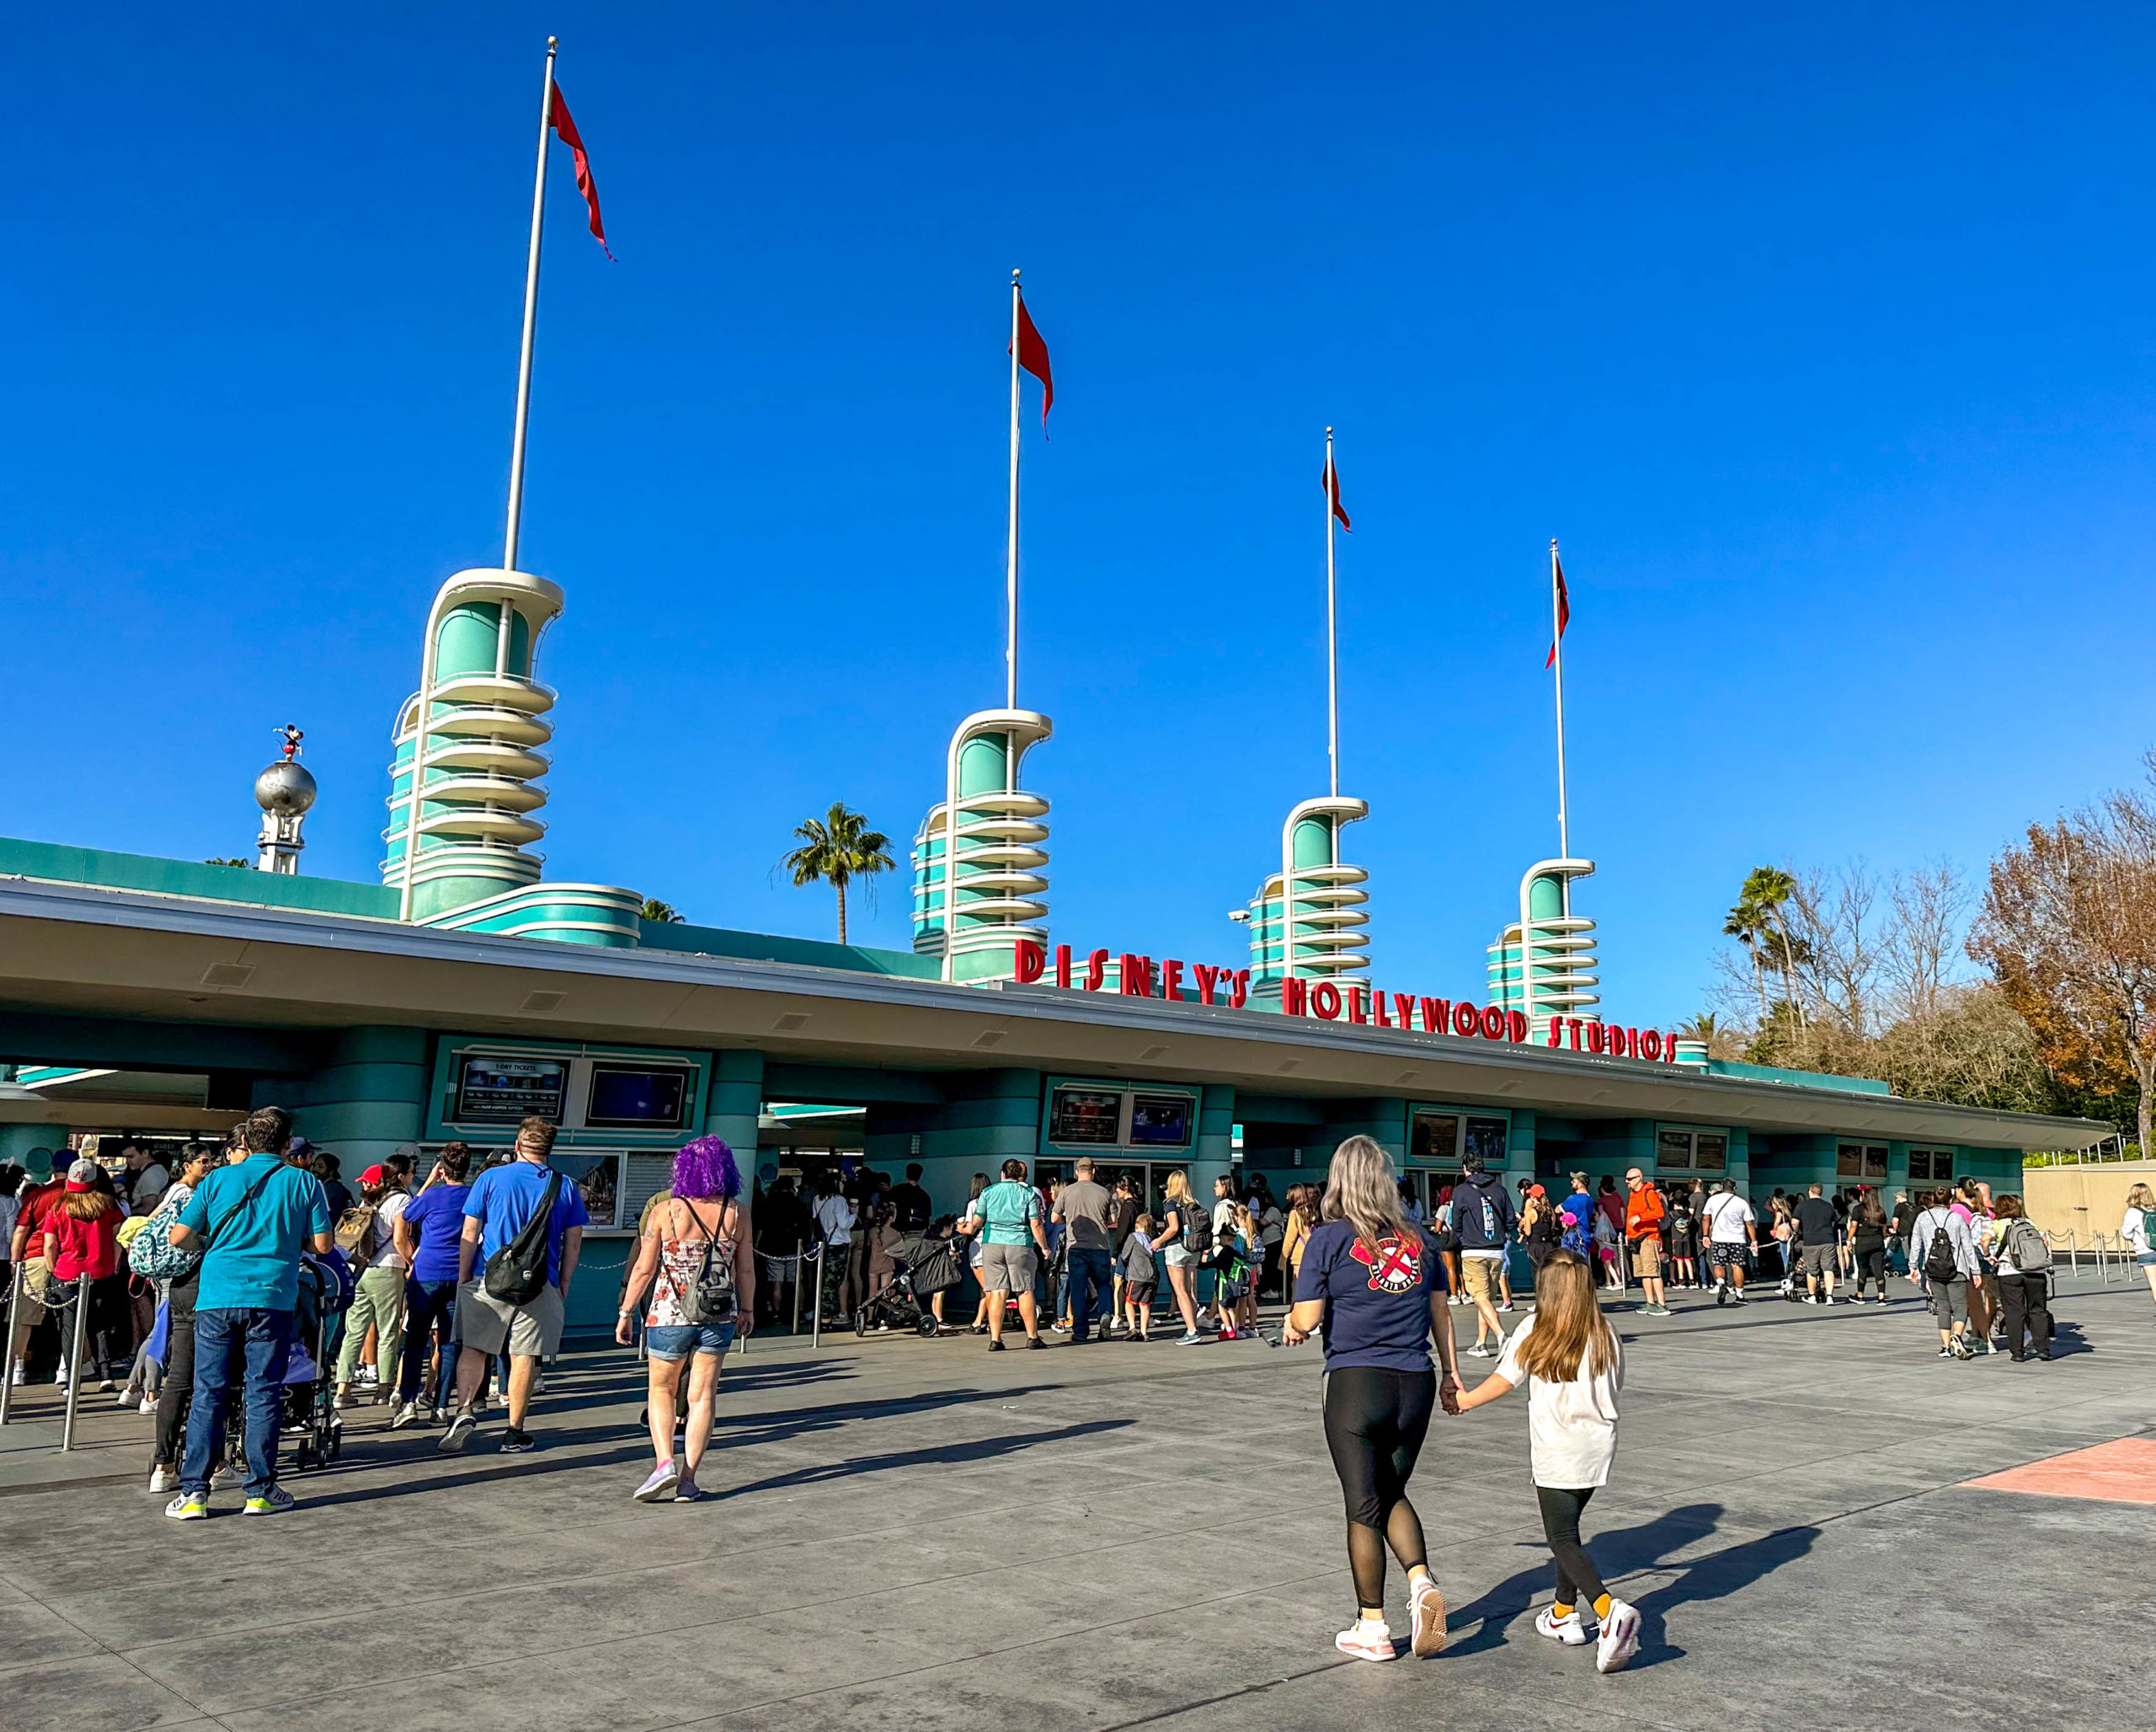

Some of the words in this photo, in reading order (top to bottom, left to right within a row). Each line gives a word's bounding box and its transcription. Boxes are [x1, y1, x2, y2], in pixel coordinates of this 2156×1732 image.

[1013, 938, 1251, 1009] DISNEY'S
[1282, 976, 1527, 1044] HOLLYWOOD
[1547, 1016, 1678, 1065] STUDIOS
[1371, 1264, 1399, 1291] ATLANTA
[1401, 1259, 1419, 1289] BRAVES
